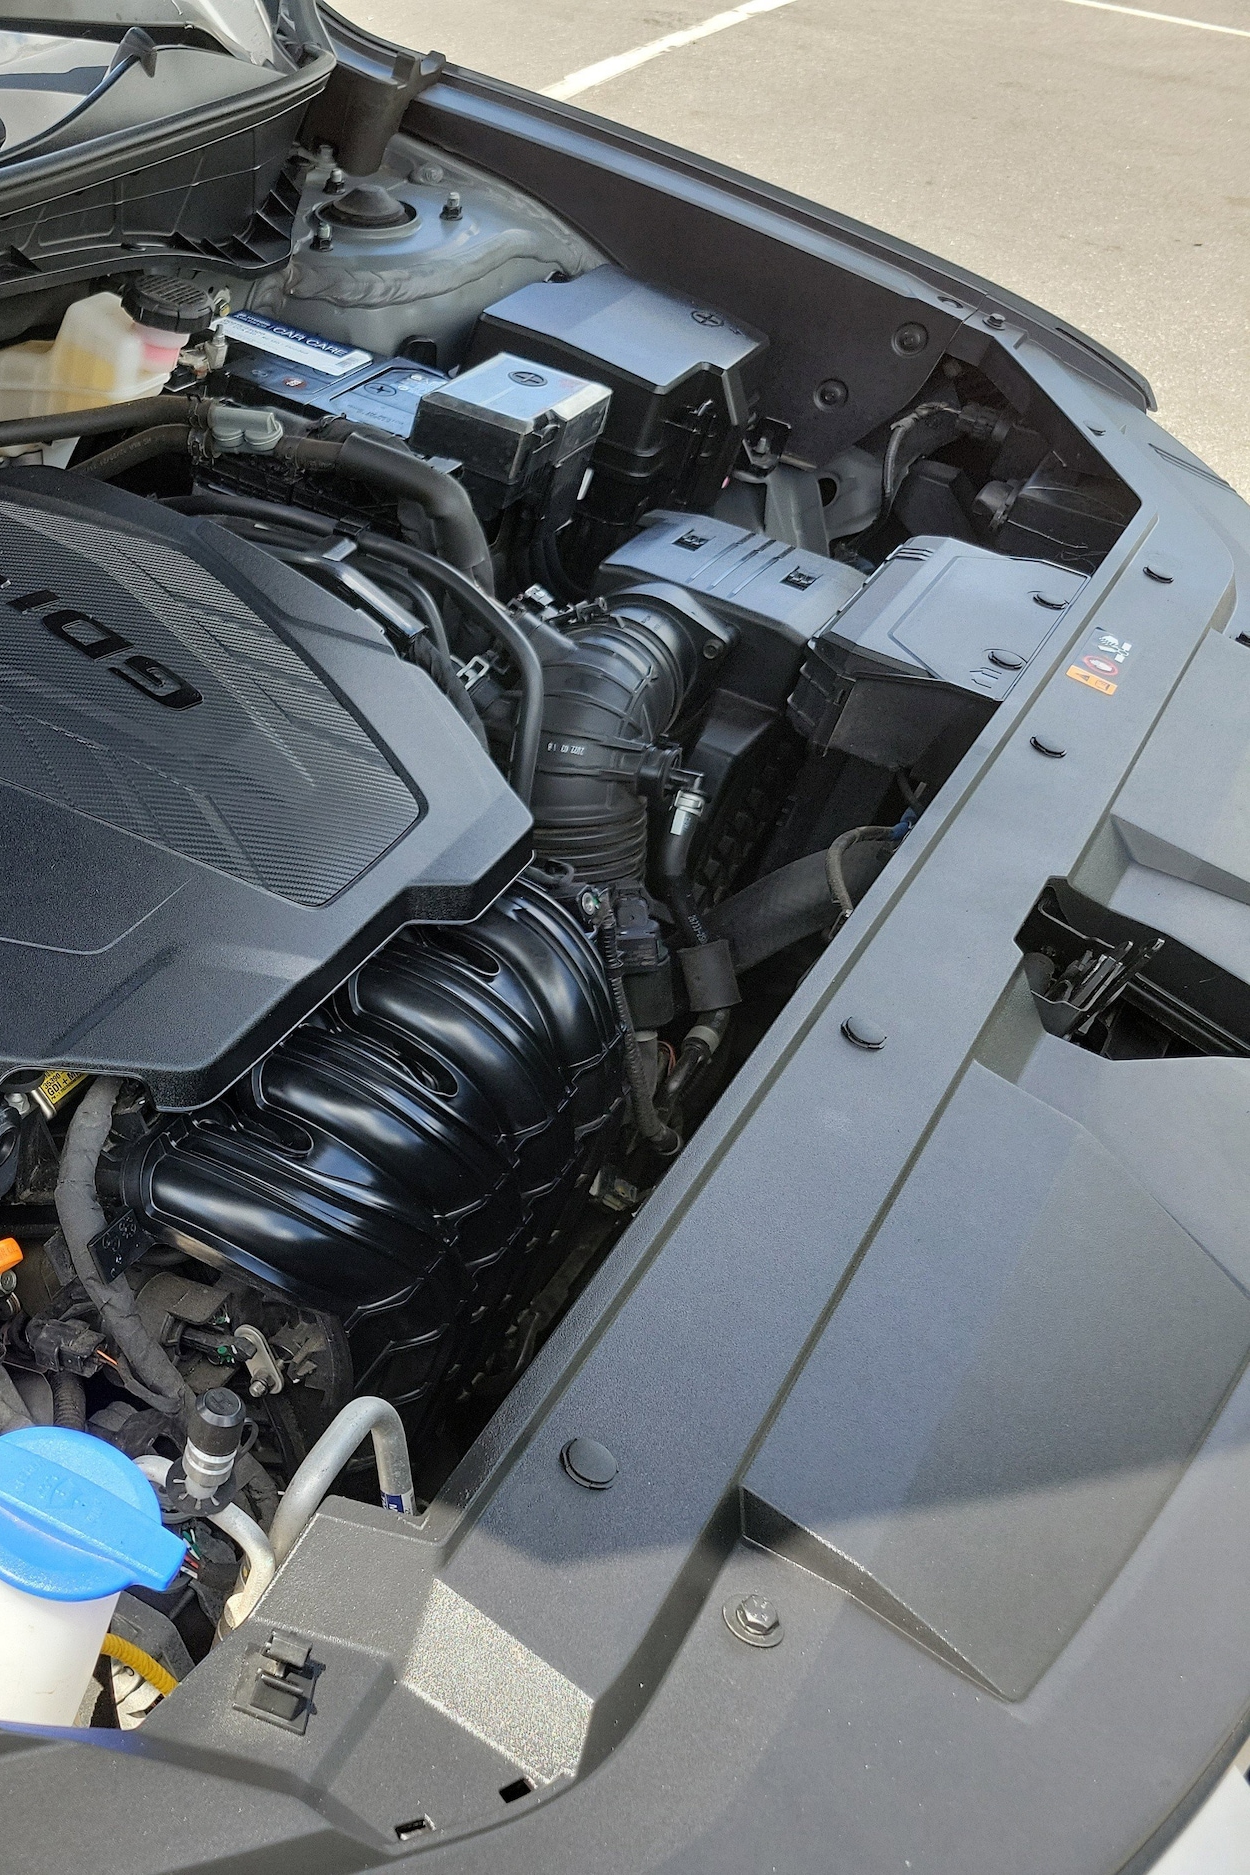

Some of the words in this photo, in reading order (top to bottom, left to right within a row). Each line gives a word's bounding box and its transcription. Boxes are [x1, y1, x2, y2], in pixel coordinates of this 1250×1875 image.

[272, 326, 307, 342] CAR
[305, 338, 348, 357] CARE
[6, 589, 204, 711] GDI
[47, 1081, 62, 1096] GDI
